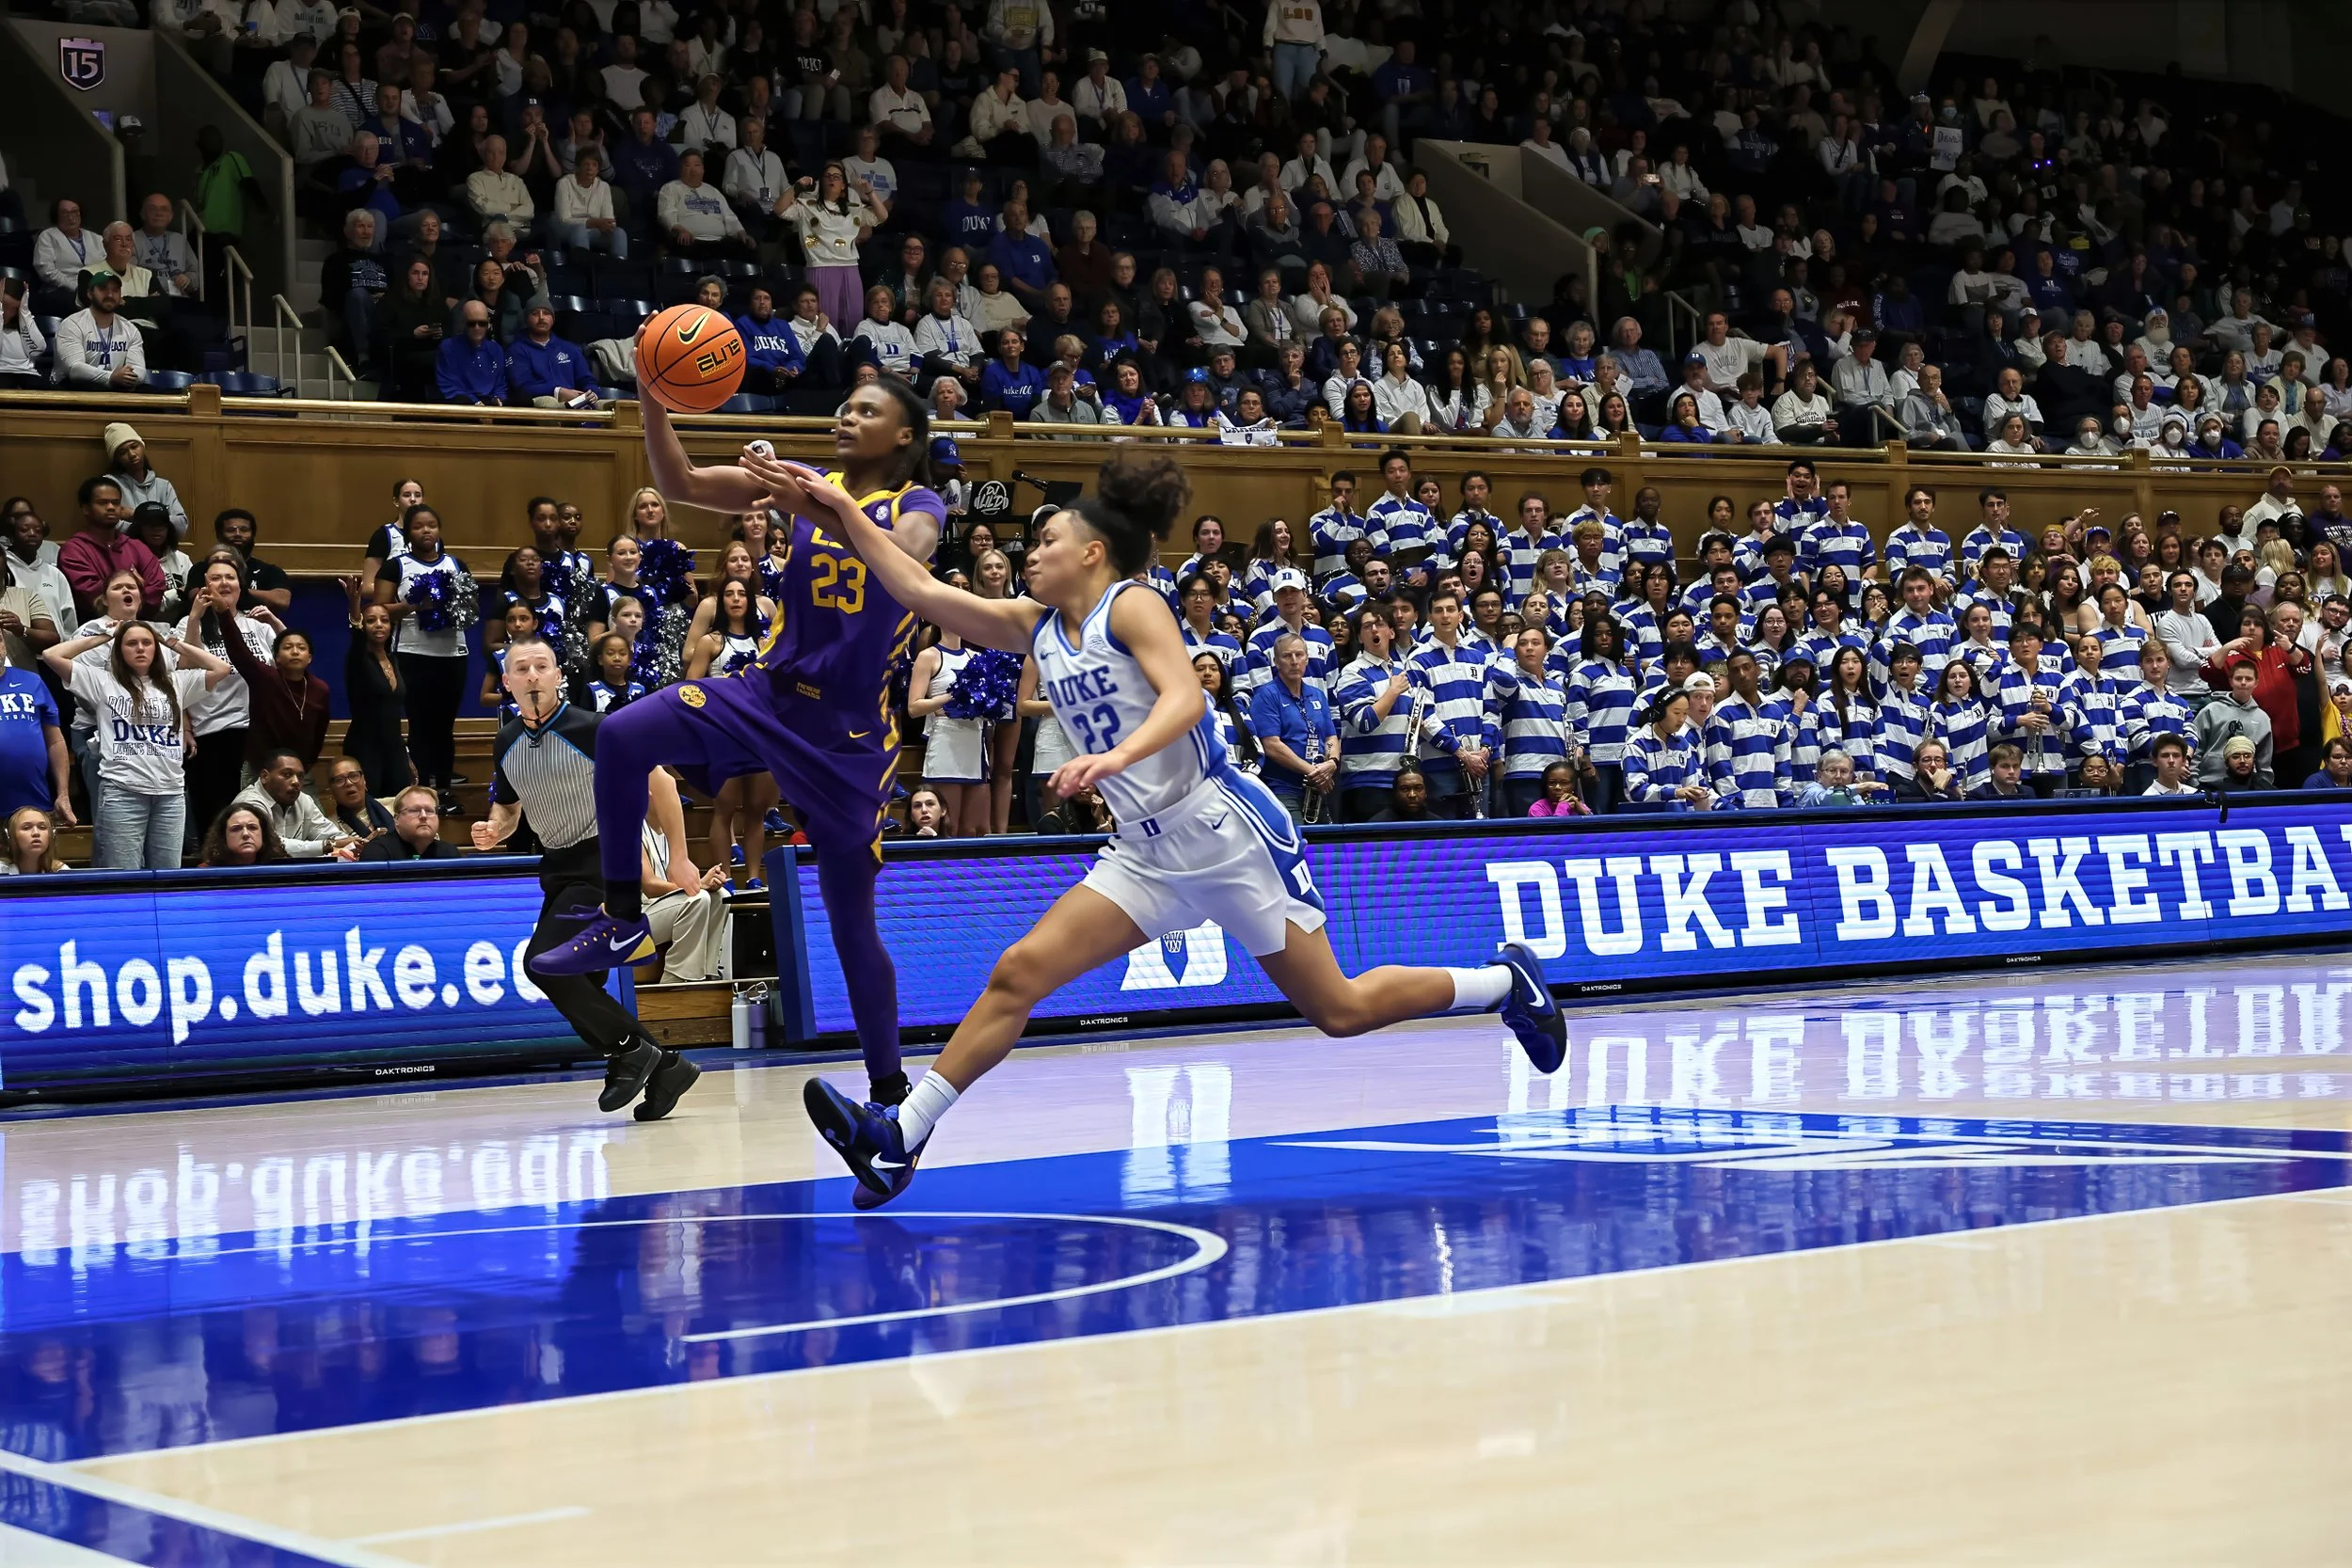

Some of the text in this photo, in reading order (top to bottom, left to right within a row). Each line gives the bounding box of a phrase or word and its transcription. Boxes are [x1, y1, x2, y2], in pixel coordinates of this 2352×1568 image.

[68, 52, 100, 79] 15
[755, 335, 788, 355] DUKE
[984, 484, 997, 497] DJ
[810, 553, 866, 614] 23
[1047, 666, 1117, 709] DUKE
[0, 692, 35, 714] KE
[112, 720, 181, 747] DUKE
[1070, 704, 1120, 755] 22
[1485, 824, 2352, 959] DUKE BASKETBA
[13, 923, 548, 1047] shop.duke.e
[1079, 1017, 1128, 1026] DAKTRONICS
[374, 1066, 435, 1076] DAKTRONICS
